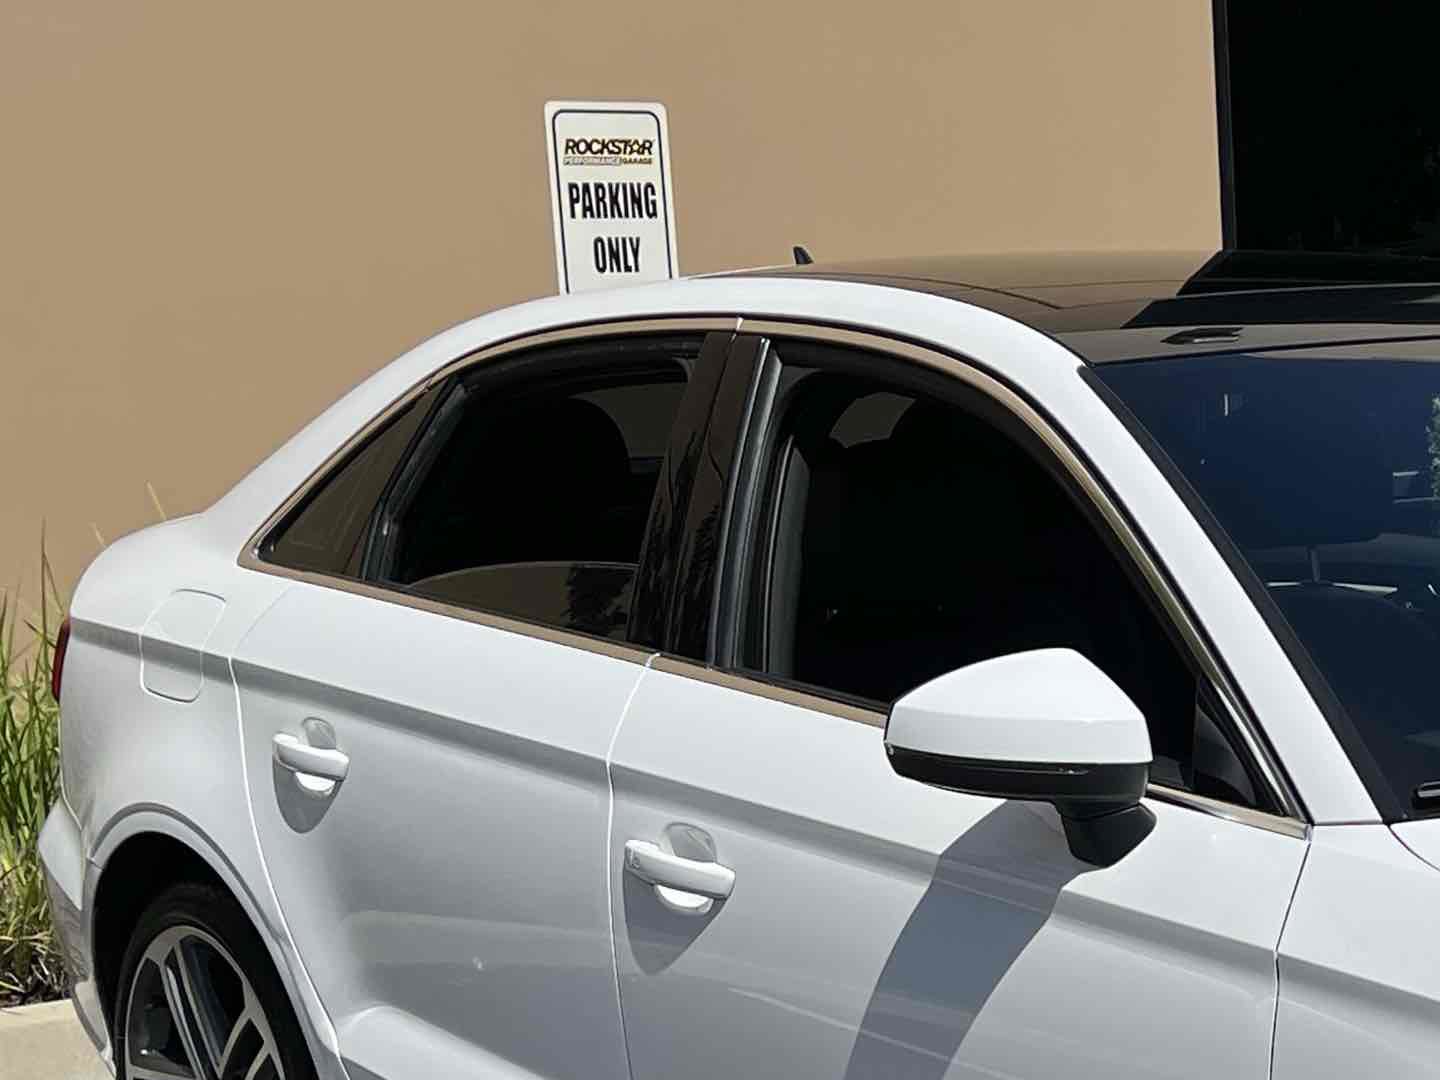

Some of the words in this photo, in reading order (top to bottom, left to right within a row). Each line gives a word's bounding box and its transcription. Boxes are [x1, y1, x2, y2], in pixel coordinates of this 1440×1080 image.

[564, 138, 654, 155] ROCKSTAR
[567, 182, 658, 219] PARKING
[593, 236, 641, 274] ONLY
